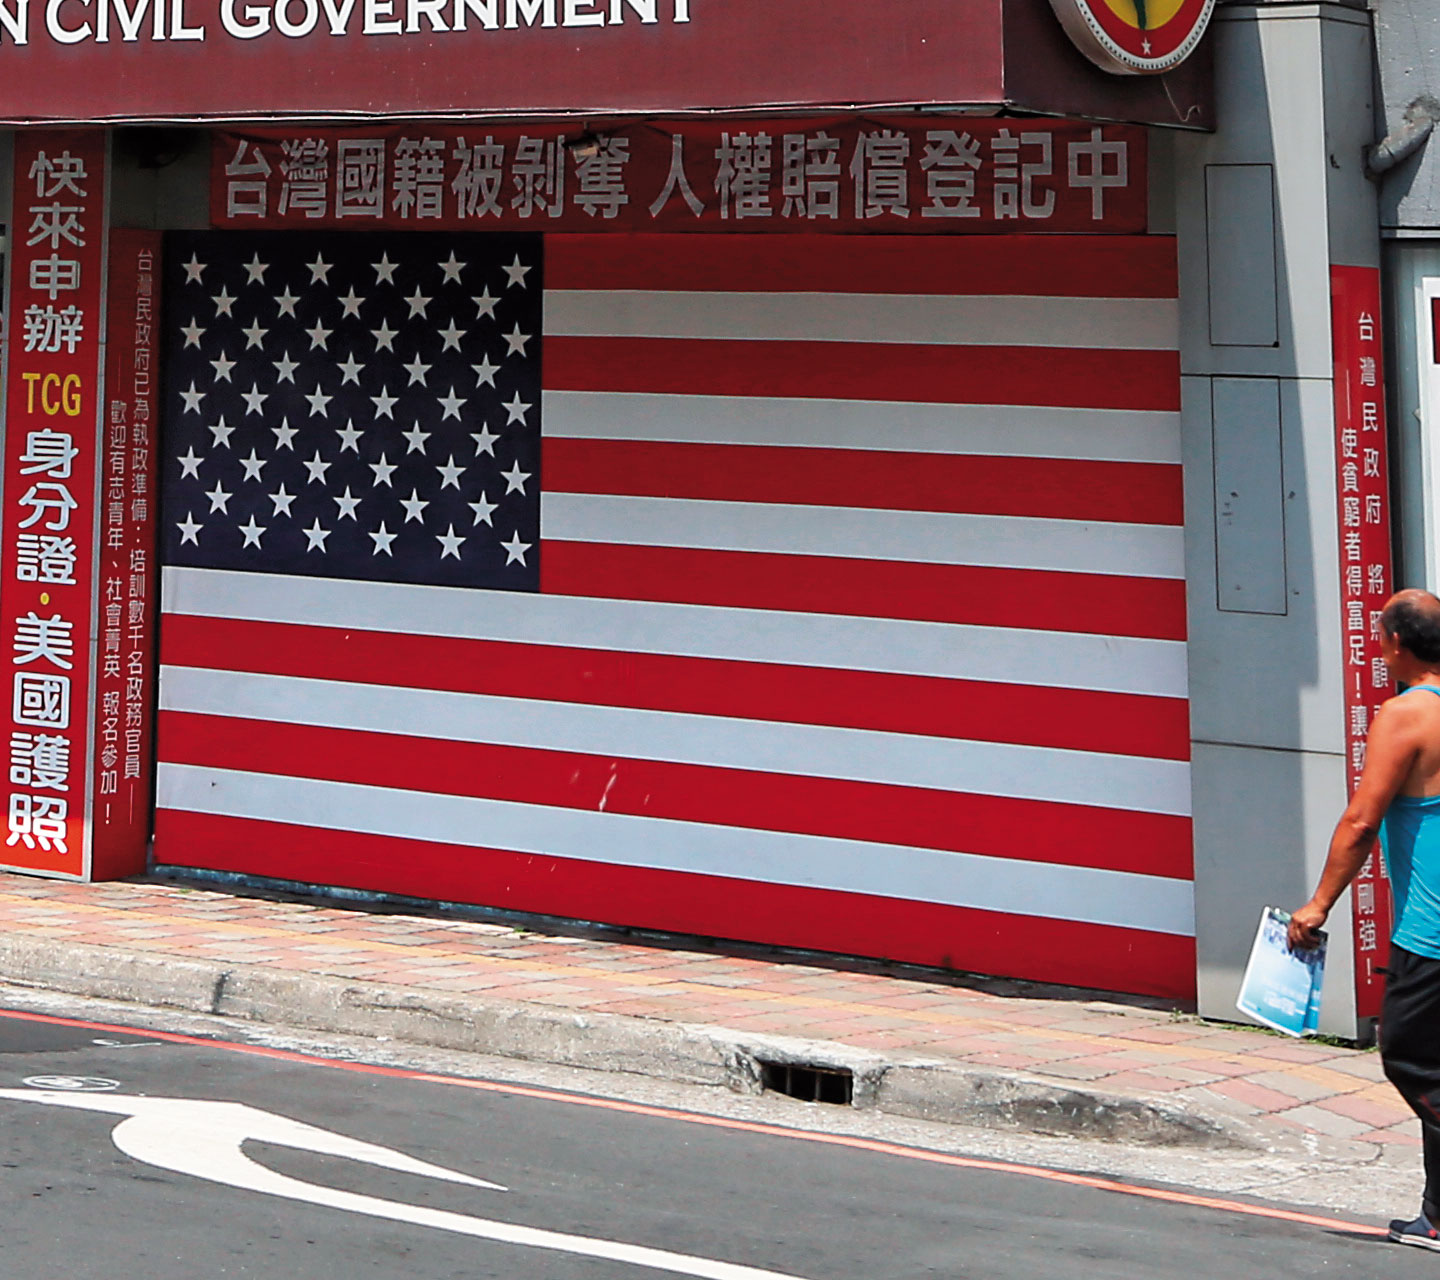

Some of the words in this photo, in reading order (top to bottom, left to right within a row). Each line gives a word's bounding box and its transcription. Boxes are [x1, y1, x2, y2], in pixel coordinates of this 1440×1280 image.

[648, 126, 1128, 224] 人權賠償登記中
[21, 374, 82, 417] TCG
